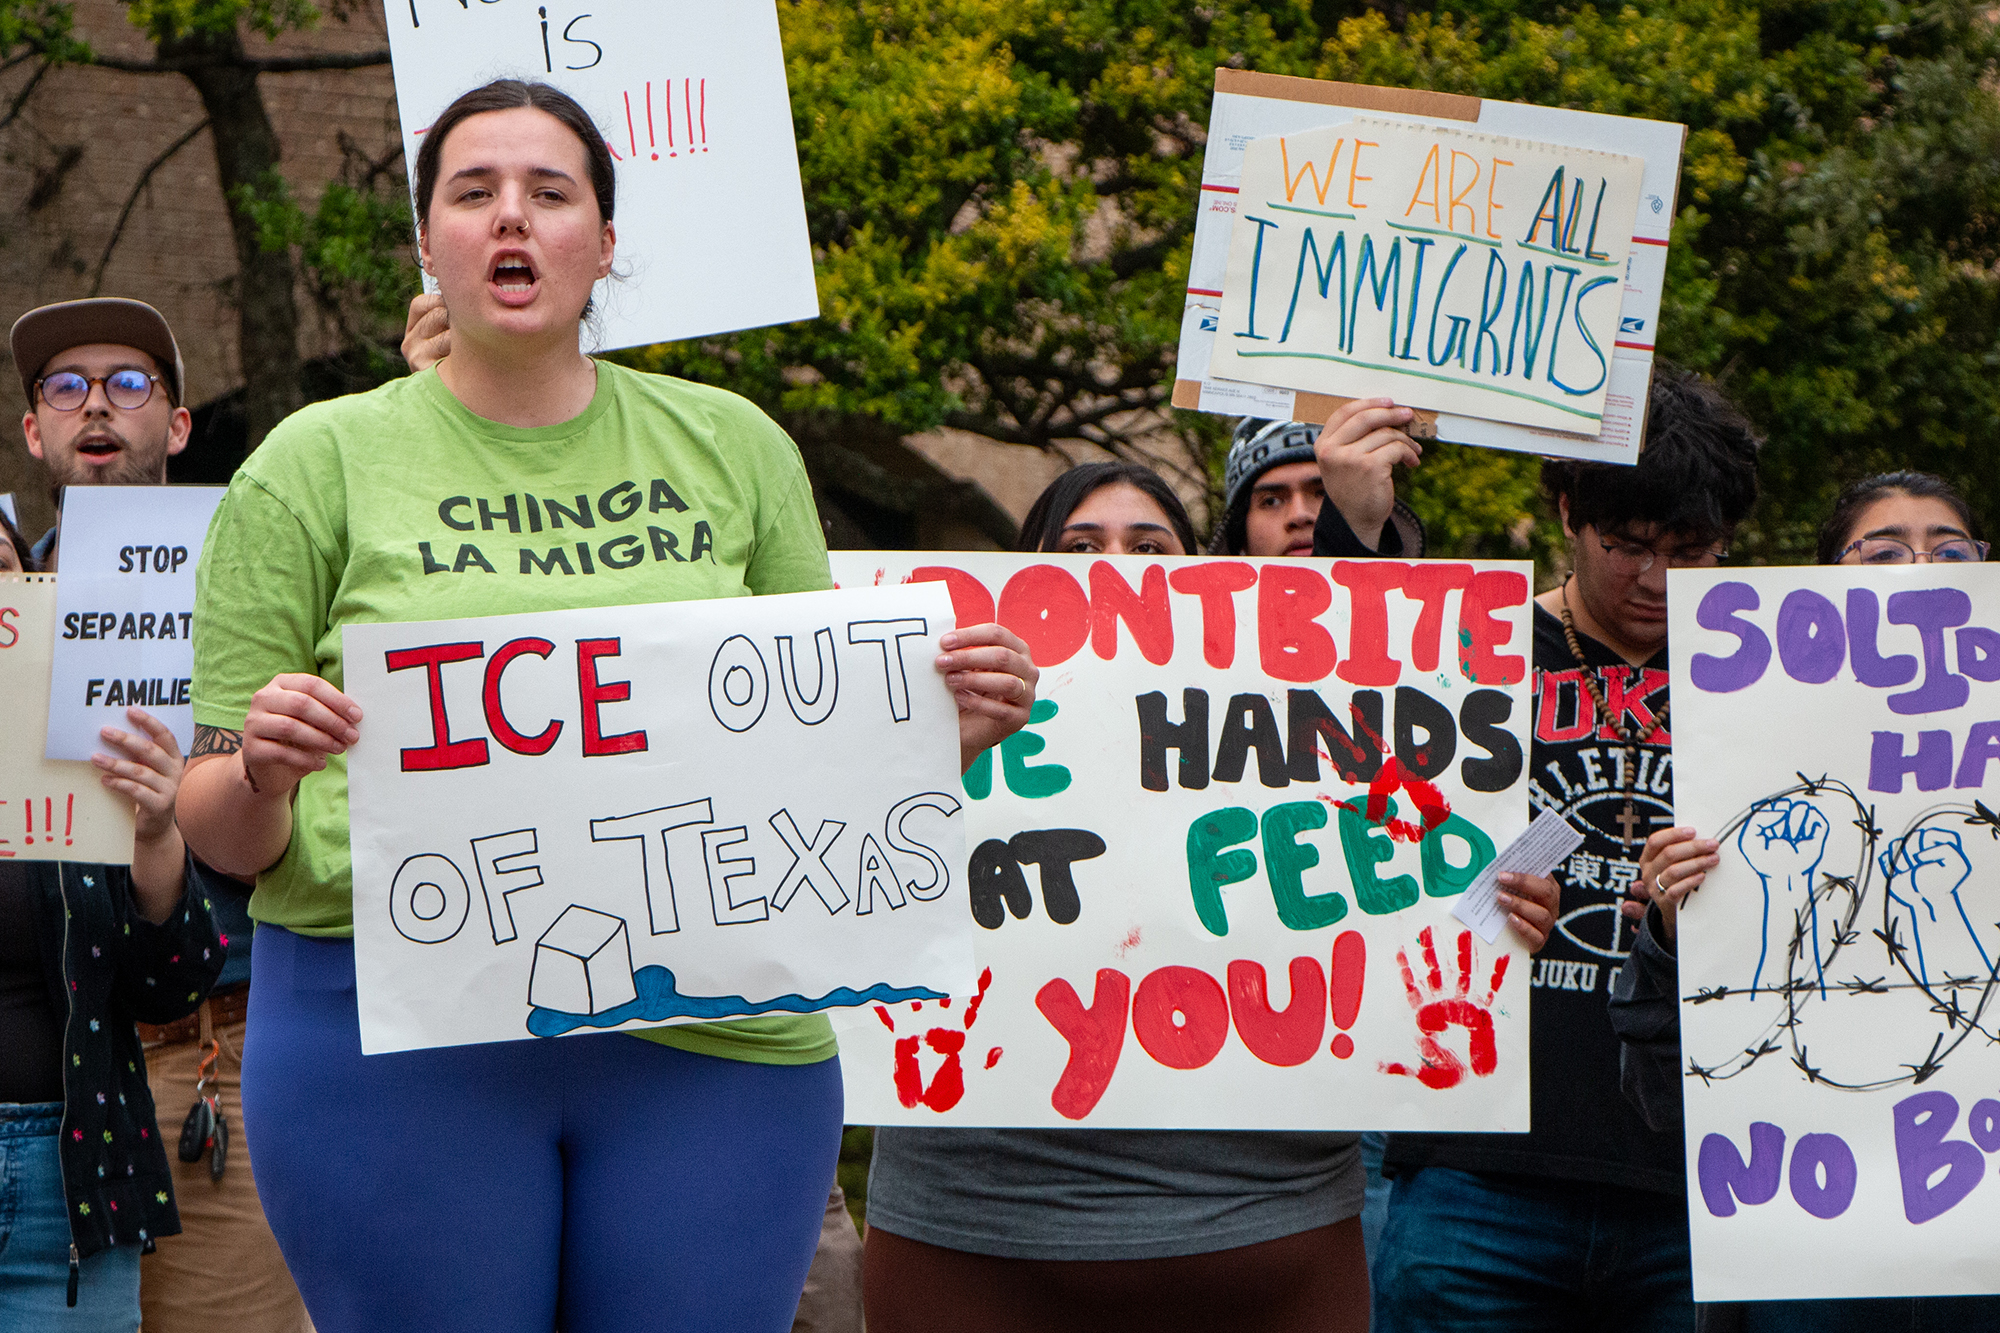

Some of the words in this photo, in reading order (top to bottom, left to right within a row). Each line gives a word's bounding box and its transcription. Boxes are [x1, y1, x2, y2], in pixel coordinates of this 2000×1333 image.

[538, 6, 602, 73] is
[1280, 138, 1379, 208] WE
[1405, 143, 1514, 240] ARE
[1524, 165, 1609, 261] ALL
[418, 540, 496, 576] LA
[518, 520, 716, 575] MIGRA
[437, 478, 690, 534] CHINGA
[118, 545, 188, 573] STOP
[385, 637, 649, 771] ICE
[708, 617, 927, 732] OUT
[1136, 687, 1523, 791] HANDS
[389, 828, 544, 944] OF
[590, 792, 962, 936] TEXAS
[1187, 796, 1497, 936] FEED
[1035, 930, 1366, 1120] YOU!
[1698, 1121, 1857, 1220] NO
